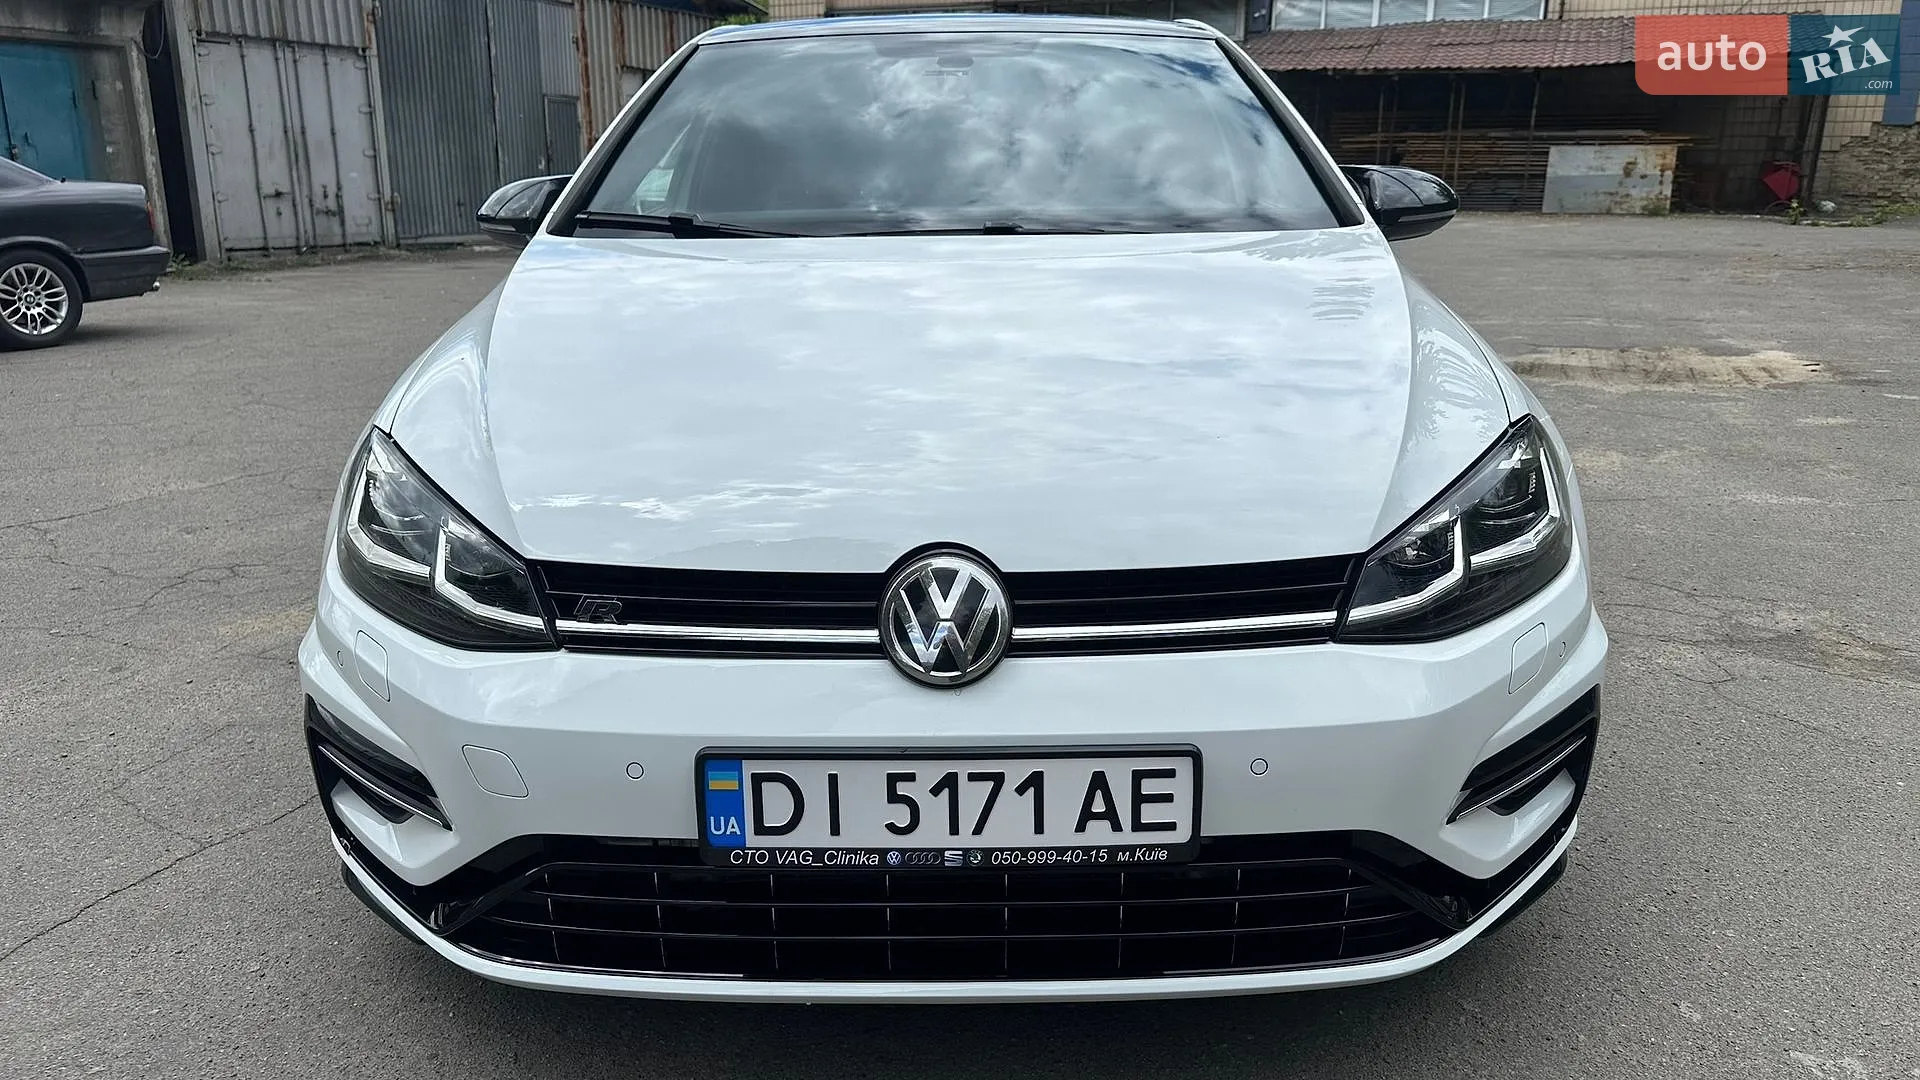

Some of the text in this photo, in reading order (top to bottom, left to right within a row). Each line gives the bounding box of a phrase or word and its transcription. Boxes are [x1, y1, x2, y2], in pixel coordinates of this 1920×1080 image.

[749, 767, 1178, 836] DI 5171 AE
[709, 816, 742, 836] UA
[775, 849, 880, 866] VAG_Clinika
[991, 848, 1108, 865] 050-999-40-15
